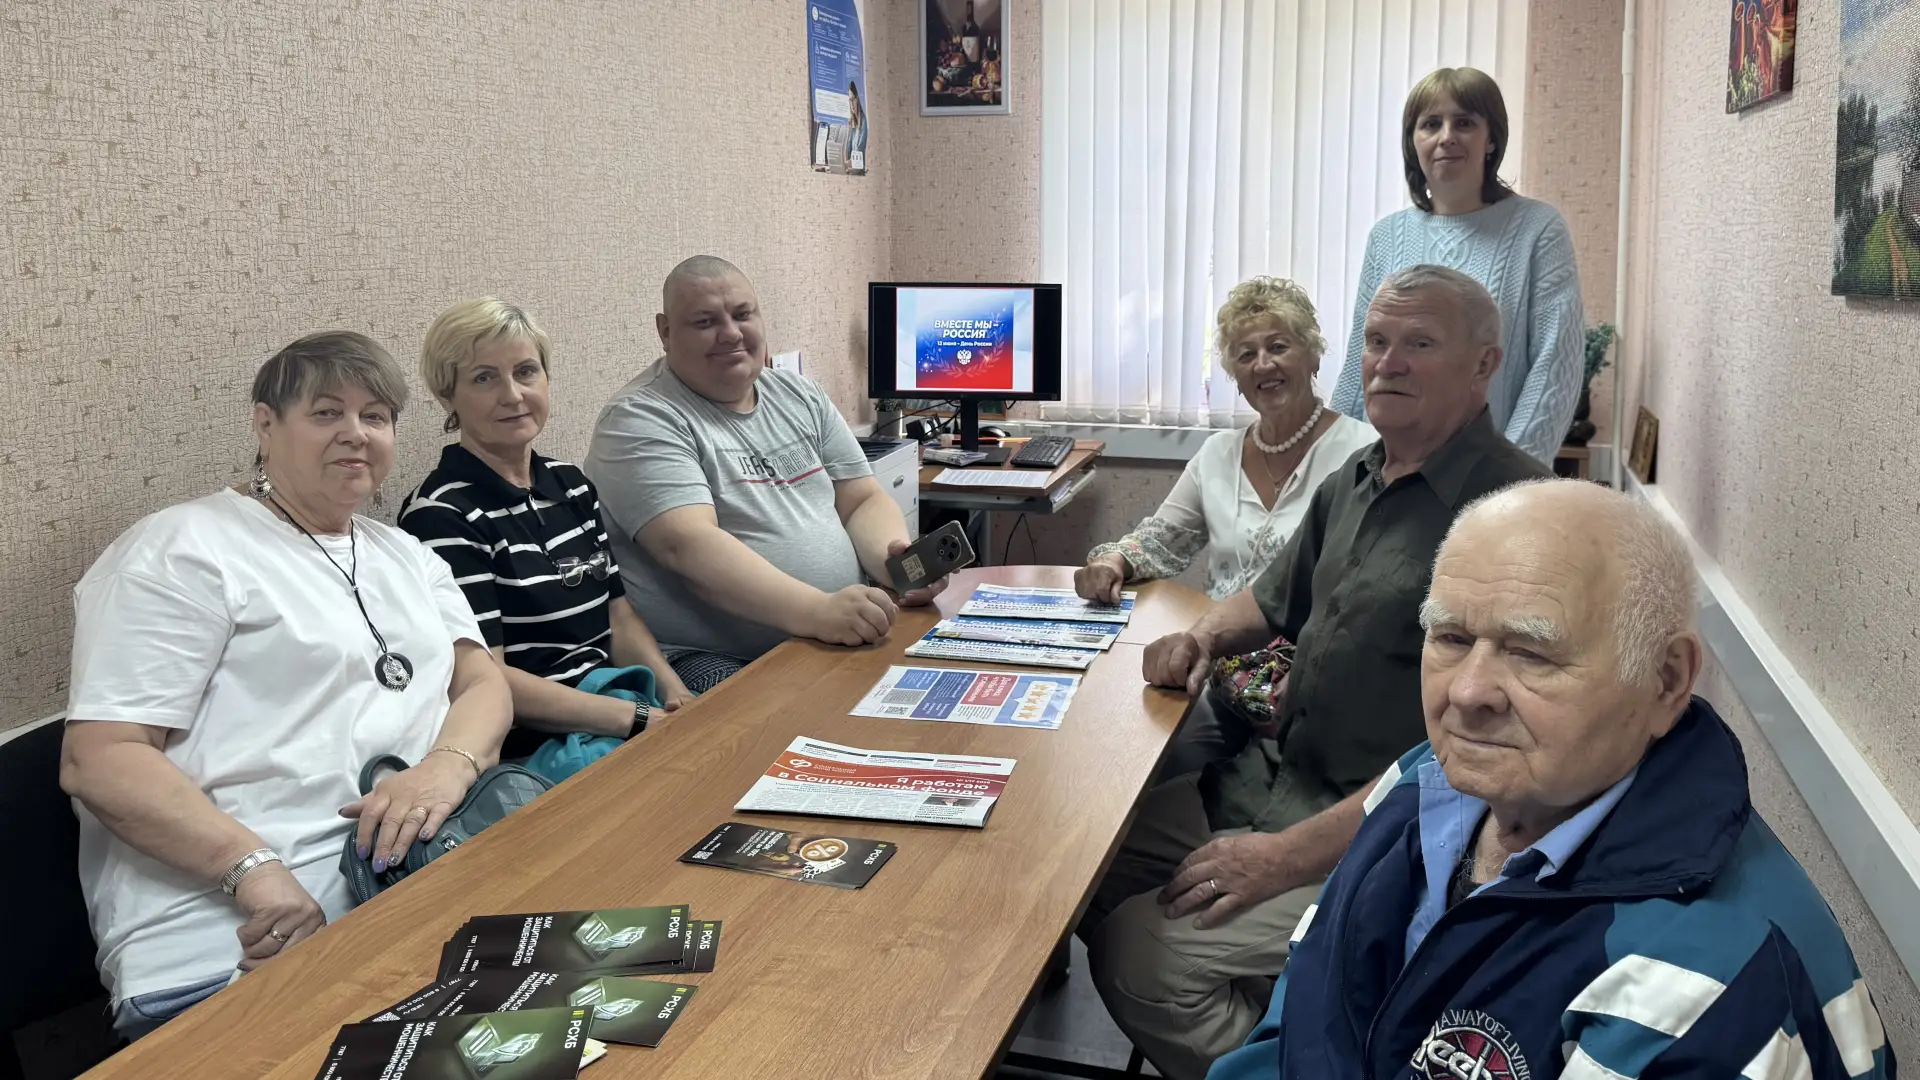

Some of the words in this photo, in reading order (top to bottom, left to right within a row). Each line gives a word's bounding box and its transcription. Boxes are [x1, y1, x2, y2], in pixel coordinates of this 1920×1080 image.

[934, 319, 973, 329] ВМЕСТЕ
[974, 320, 993, 329] МЫ
[942, 329, 987, 339] РОССИЯ
[779, 445, 816, 475] RAW
[794, 774, 916, 791] Социальном
[921, 785, 985, 796] фонде
[911, 779, 989, 790] работаю
[863, 849, 883, 866] РСХБ
[543, 916, 553, 929] КАК
[668, 916, 681, 939] РСХБ
[526, 916, 543, 956] ЗАЩИТИТЬСЯ
[699, 930, 713, 950] РСХБ
[543, 973, 560, 986] КАК
[496, 971, 541, 1013] МОШЕННИЧЕС
[509, 972, 549, 1011] ЗАЩИТИТЬСЯ
[658, 995, 682, 1019] РСХБ
[423, 1021, 438, 1037] КАК
[1440, 1012, 1452, 1028] A
[1449, 1009, 1488, 1026] WAY
[1484, 1017, 1506, 1036] OF
[564, 1019, 582, 1049] РСХБ
[397, 1022, 426, 1071] ЗАЩИТИТЬСЯ
